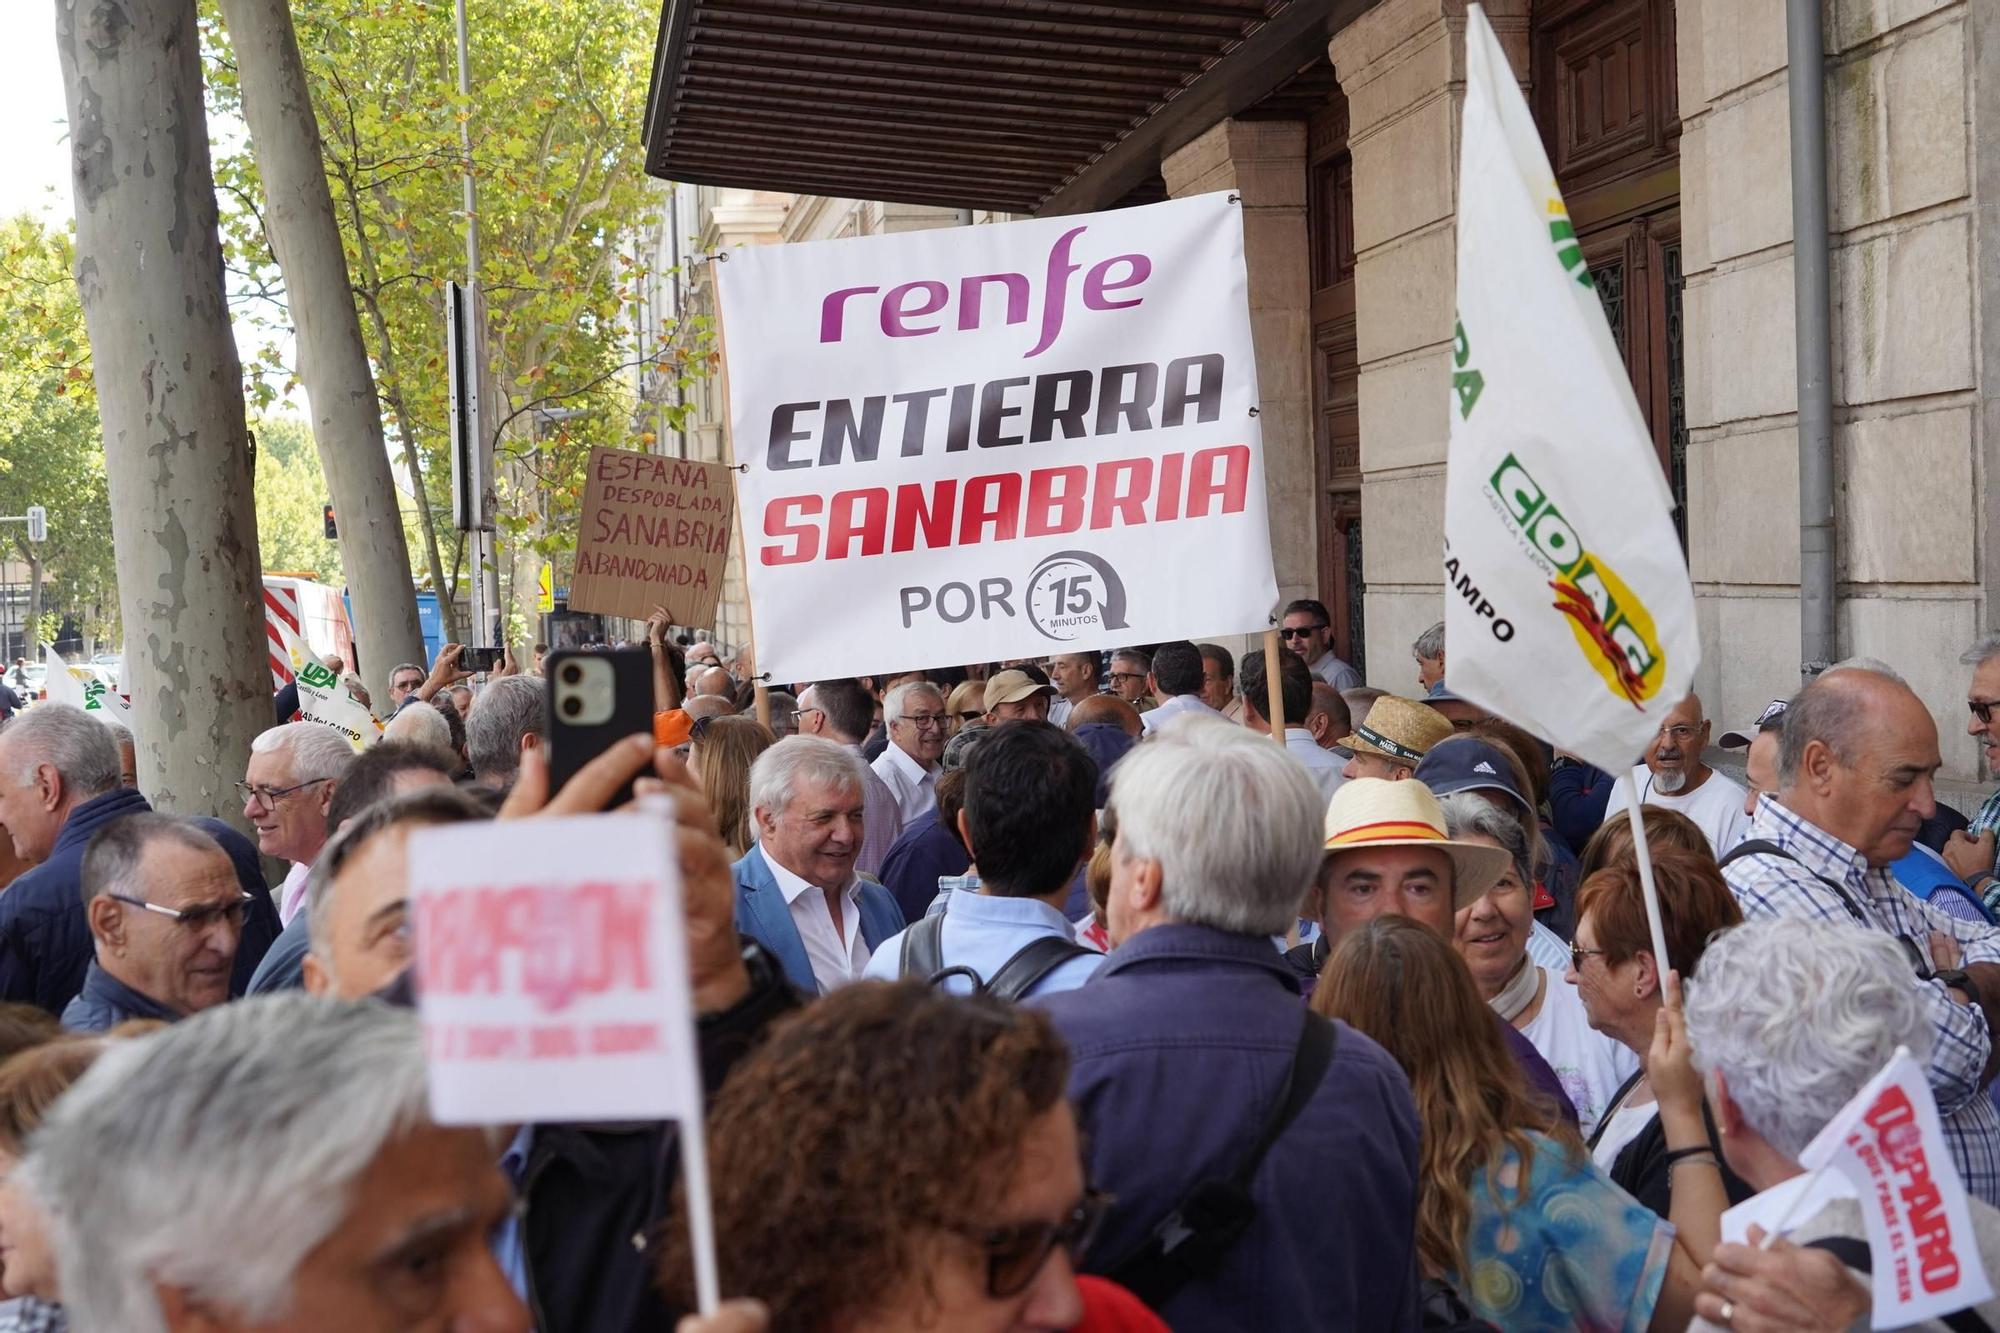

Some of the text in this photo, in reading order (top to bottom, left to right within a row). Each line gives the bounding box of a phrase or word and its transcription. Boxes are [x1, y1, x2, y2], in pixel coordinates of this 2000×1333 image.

[820, 225, 1152, 358] renfe
[766, 353, 1225, 471] ENTIERRA
[597, 453, 708, 489] ESPAÑA
[760, 444, 1250, 566] SANABRIA
[577, 550, 709, 591] ABANDONADA
[1442, 536, 1516, 644] AMPO
[900, 577, 1016, 629] POR
[1048, 574, 1093, 616] 15
[1050, 615, 1098, 628] MINUTOS
[299, 661, 338, 690] UPA
[1876, 1180, 1899, 1228] PARE
[1890, 1230, 1905, 1251] EL
[1895, 1256, 1913, 1303] TREN
